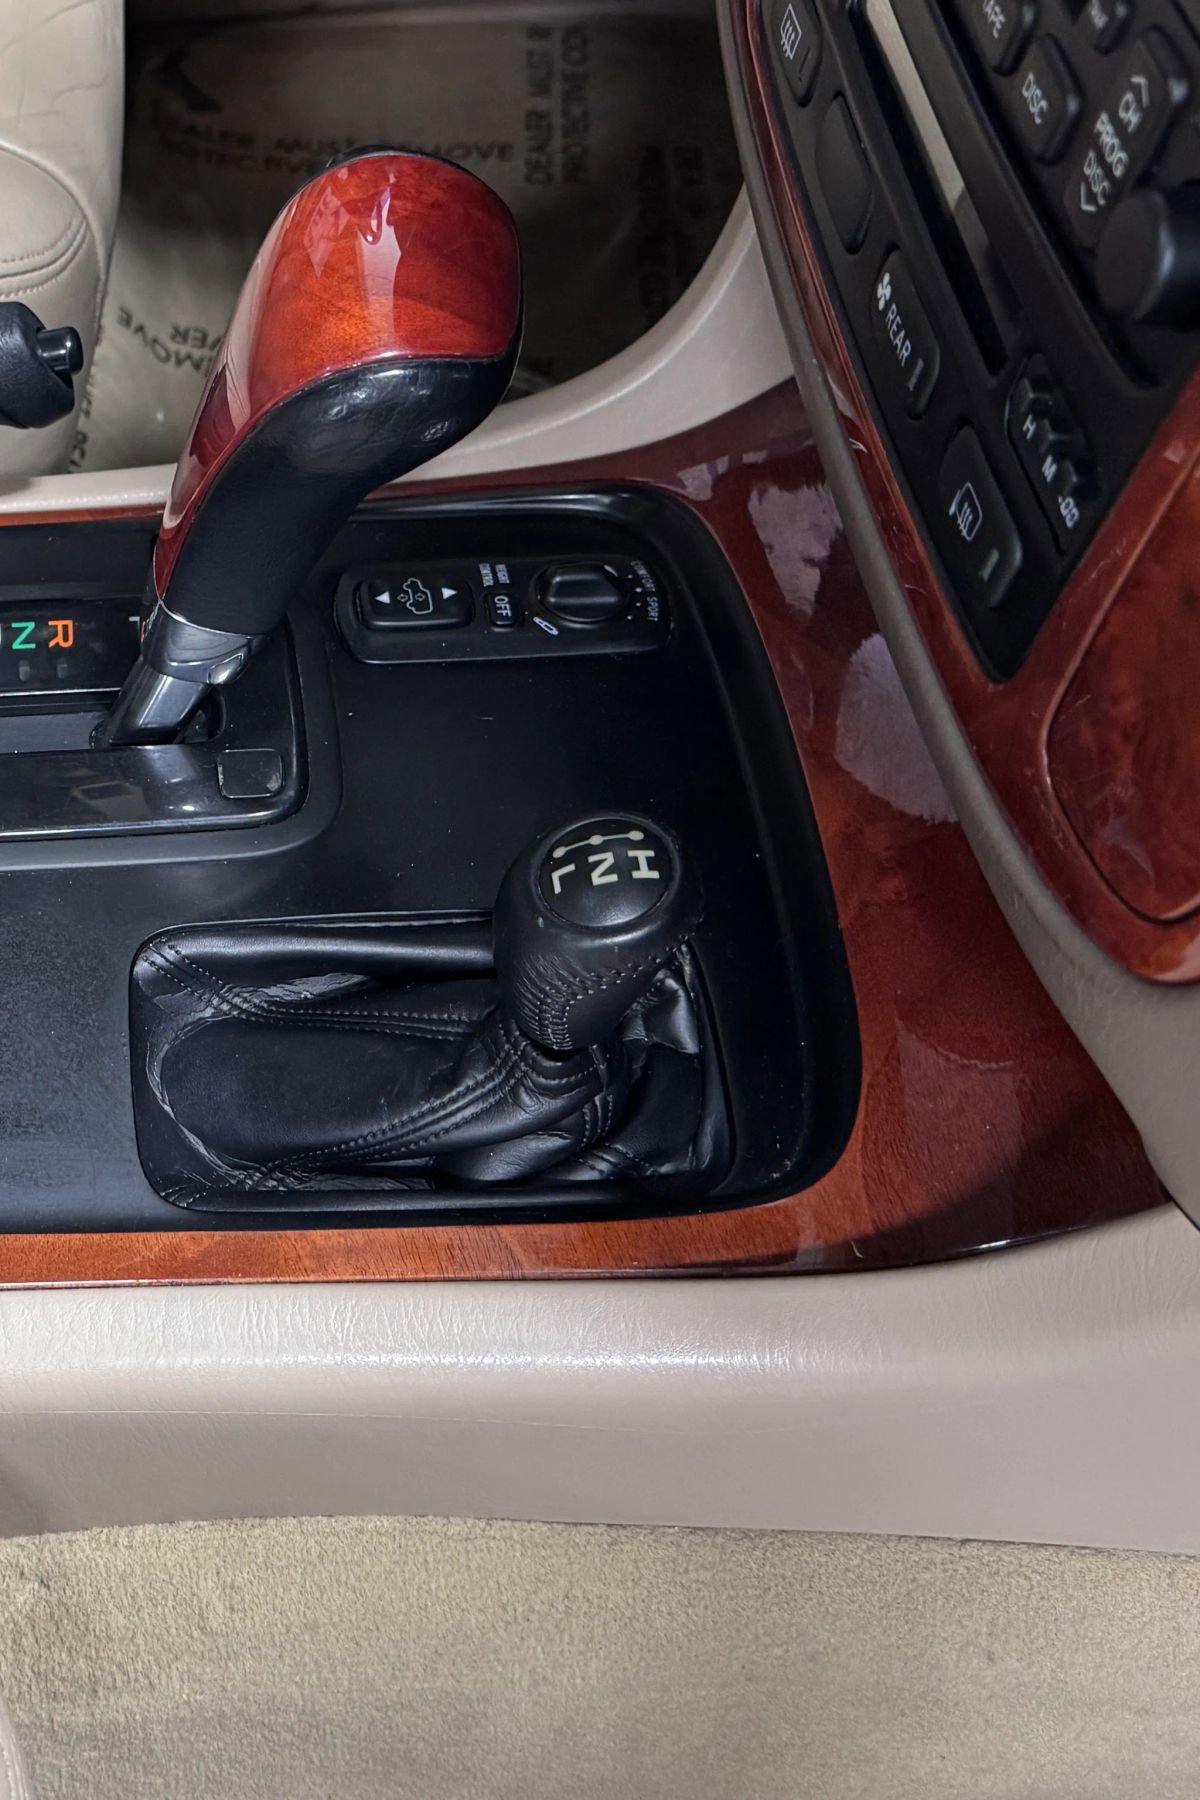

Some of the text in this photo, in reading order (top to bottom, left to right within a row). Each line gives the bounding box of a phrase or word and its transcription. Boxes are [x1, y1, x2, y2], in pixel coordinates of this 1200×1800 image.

[1021, 72, 1048, 125] DISC
[1118, 91, 1143, 133] CH
[1094, 112, 1129, 179] PROG
[1083, 149, 1111, 207] DISC
[885, 303, 912, 367] REAR
[1023, 414, 1038, 440] H
[1041, 455, 1057, 482] M
[494, 595, 512, 618] OFF
[647, 596, 659, 622] SPORT
[11, 621, 36, 650] N
[48, 619, 74, 649] R
[551, 863, 576, 895] L
[587, 851, 619, 886] N
[627, 850, 660, 879] H
